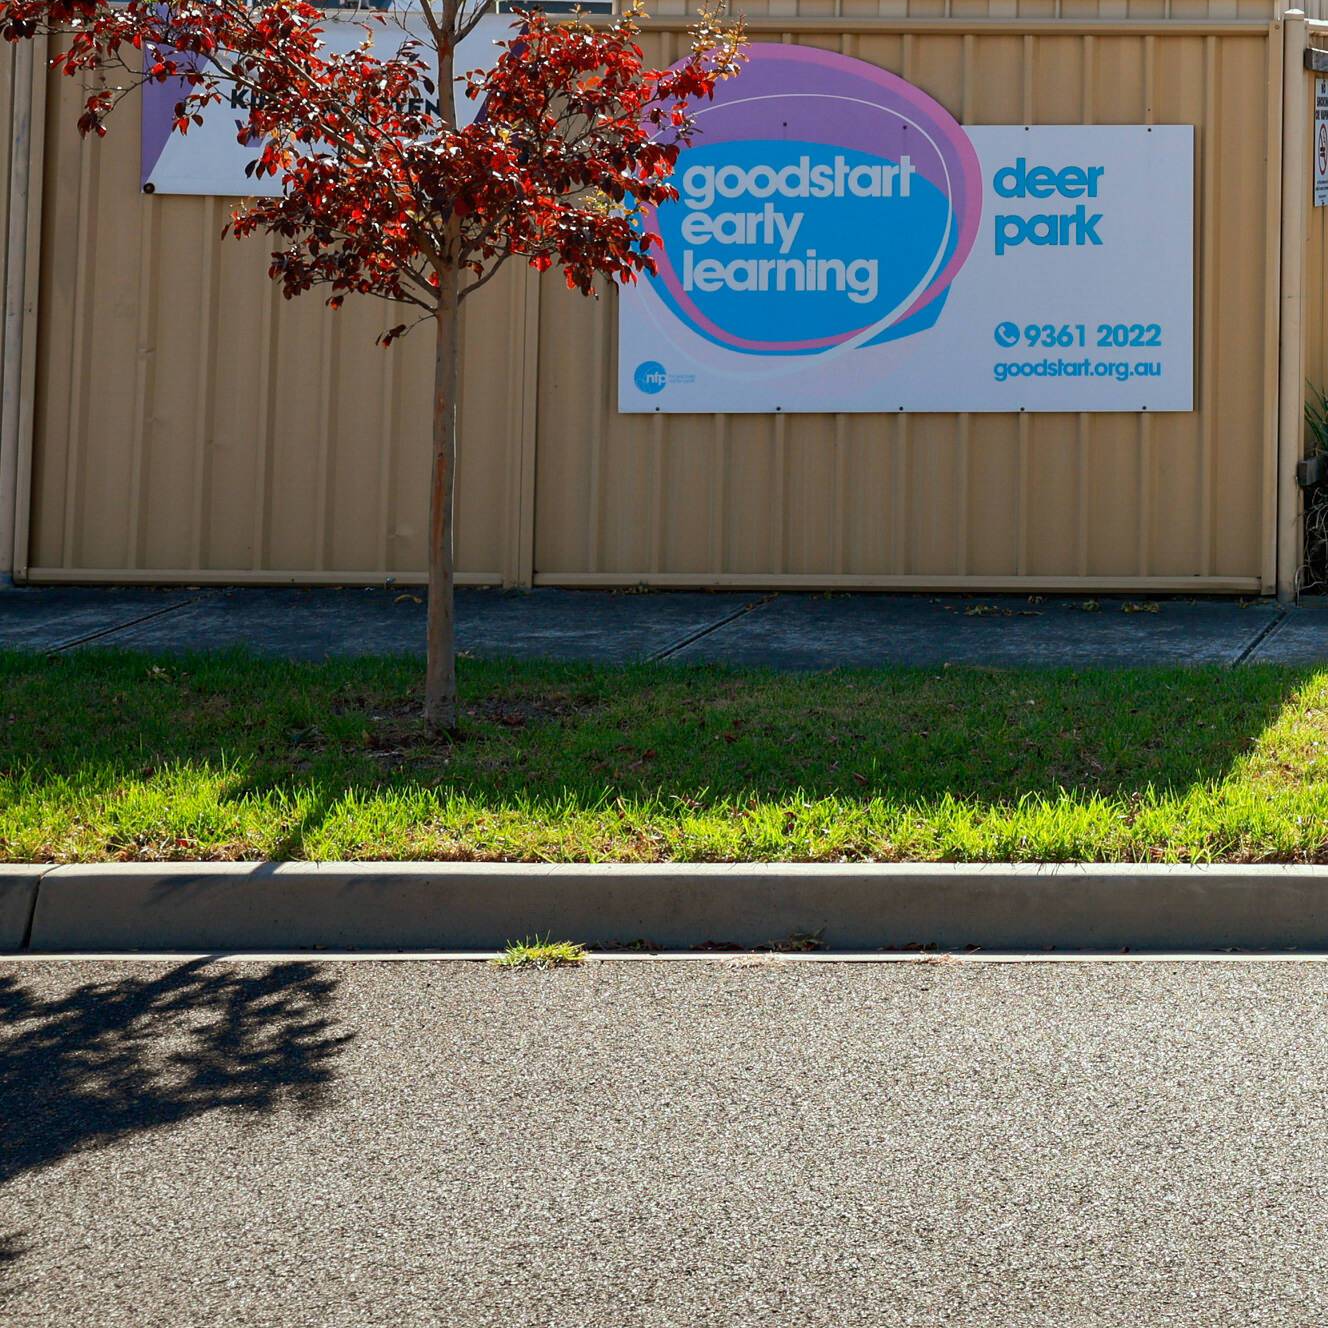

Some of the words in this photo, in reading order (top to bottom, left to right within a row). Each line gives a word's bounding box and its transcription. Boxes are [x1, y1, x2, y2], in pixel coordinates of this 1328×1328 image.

[682, 155, 915, 210] goodstart
[993, 157, 1104, 199] deer
[681, 202, 804, 254] early
[994, 204, 1104, 256] park
[682, 249, 879, 304] learning
[1023, 323, 1087, 348] 9361
[1096, 323, 1162, 348] 2022
[993, 358, 1162, 382] goodstart.org.au
